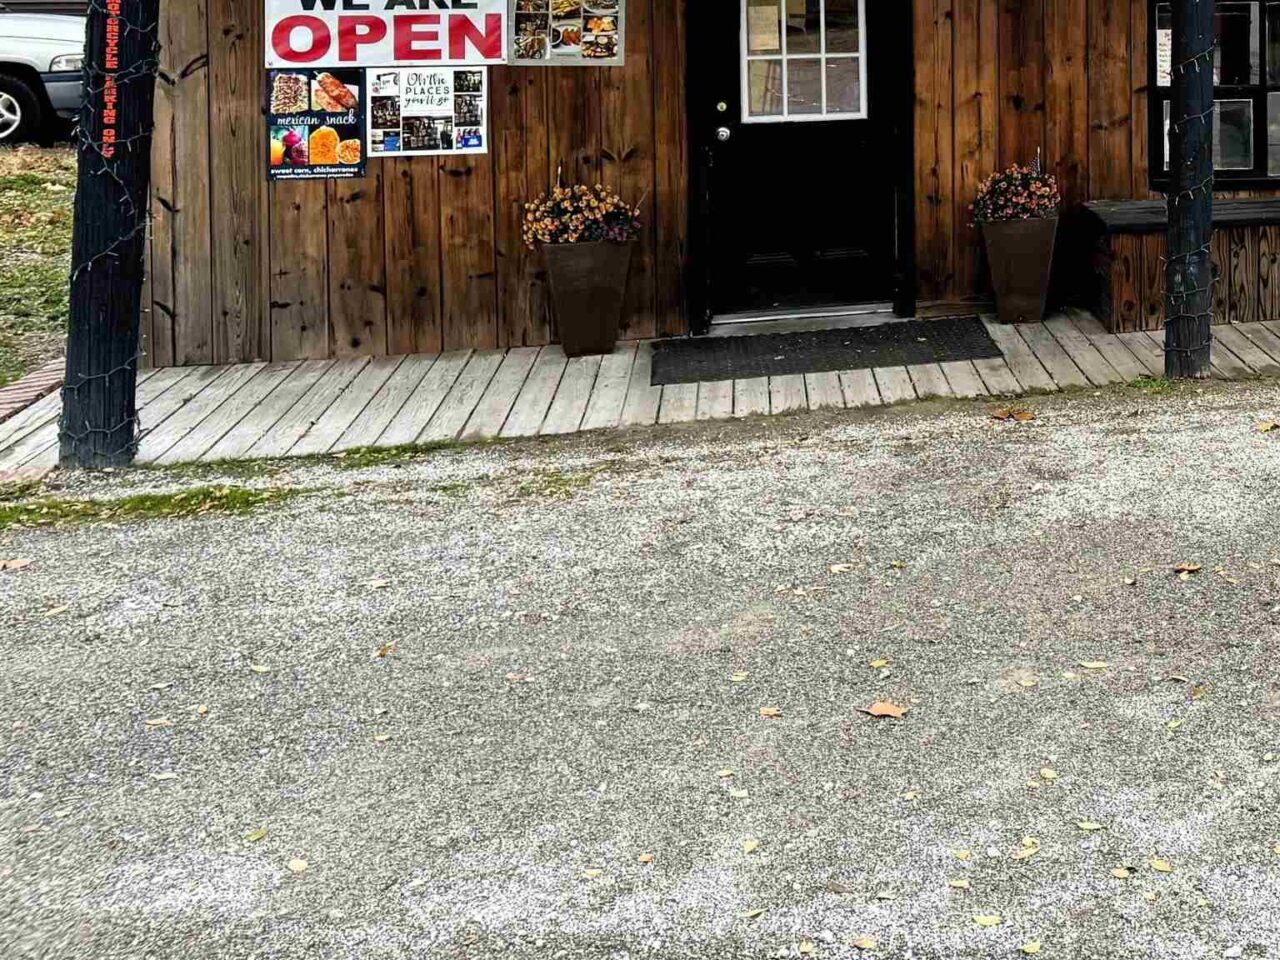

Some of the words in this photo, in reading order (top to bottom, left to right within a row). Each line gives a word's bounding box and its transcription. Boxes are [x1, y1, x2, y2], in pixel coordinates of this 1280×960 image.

[271, 13, 502, 62] OPEN
[405, 86, 450, 96] PLACES
[277, 115, 320, 125] mexican
[324, 108, 357, 125] snack
